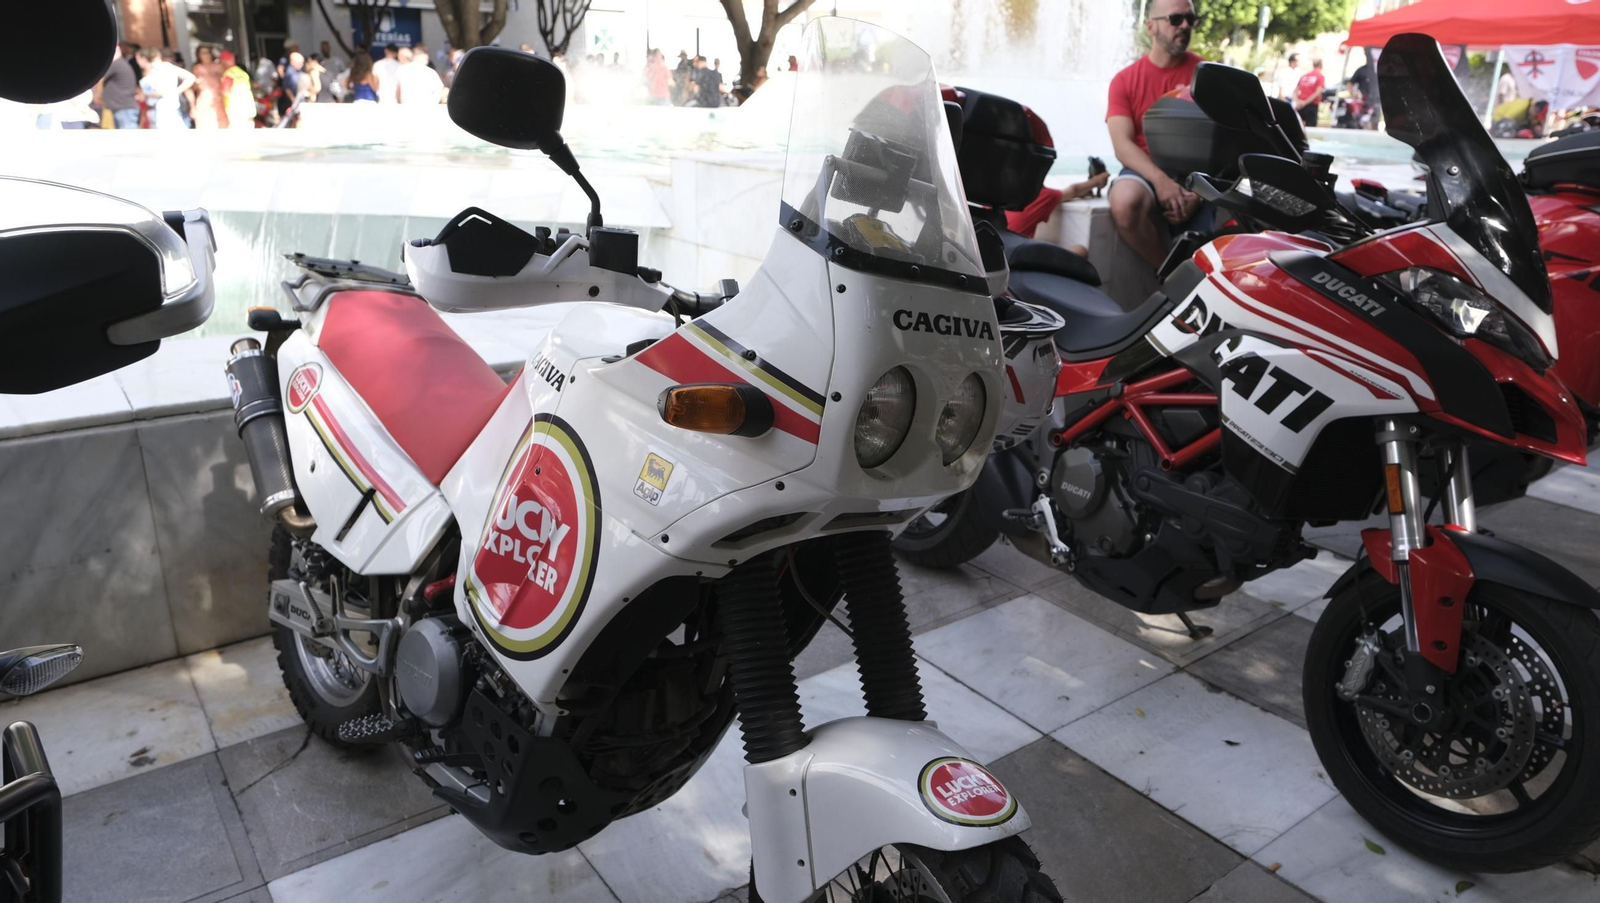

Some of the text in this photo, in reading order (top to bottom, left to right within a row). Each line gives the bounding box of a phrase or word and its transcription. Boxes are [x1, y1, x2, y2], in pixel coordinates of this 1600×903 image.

[1311, 271, 1387, 317] DUCATI
[892, 309, 995, 341] CAGIVA
[531, 351, 566, 393] CAGIVA
[1229, 420, 1252, 440] DUCATI
[636, 481, 659, 502] Agip
[1061, 481, 1092, 500] DUCATI
[936, 773, 994, 798] LUCKY
[946, 784, 1002, 807] EXPLORER
